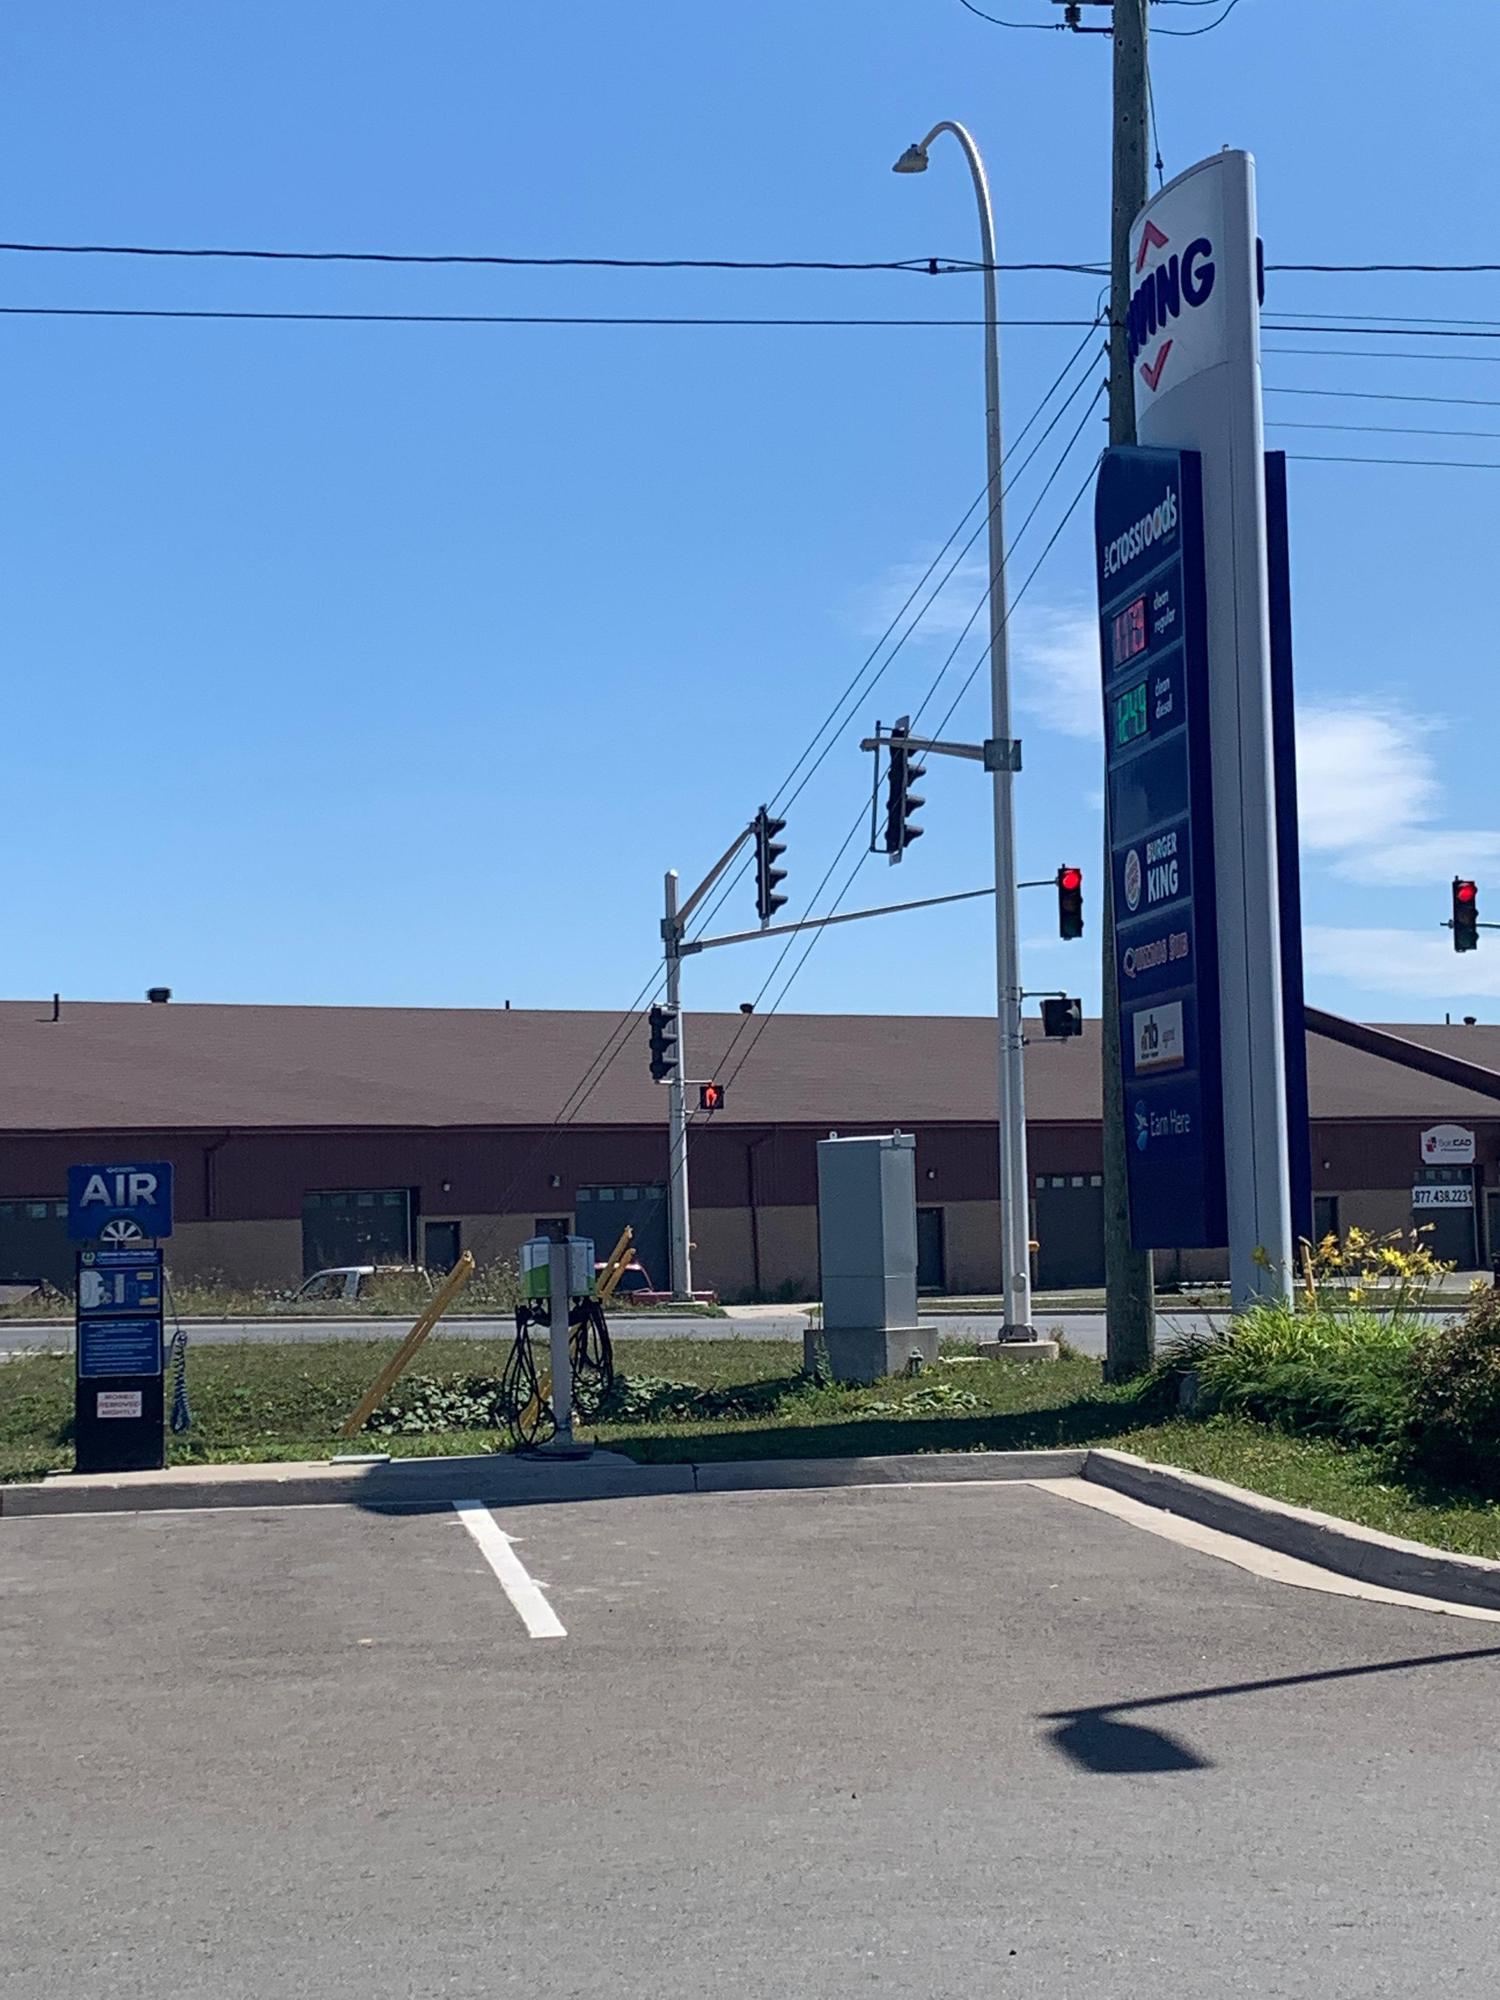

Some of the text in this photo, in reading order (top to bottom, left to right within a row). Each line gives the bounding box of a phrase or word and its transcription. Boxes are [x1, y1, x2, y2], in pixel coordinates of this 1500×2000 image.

[1154, 607, 1175, 634] regular
[1155, 693, 1173, 719] diesel
[1146, 832, 1177, 865] BURGER
[1147, 859, 1179, 903] KING
[1150, 1109, 1191, 1137] Earn Here
[79, 1172, 158, 1208] AIR
